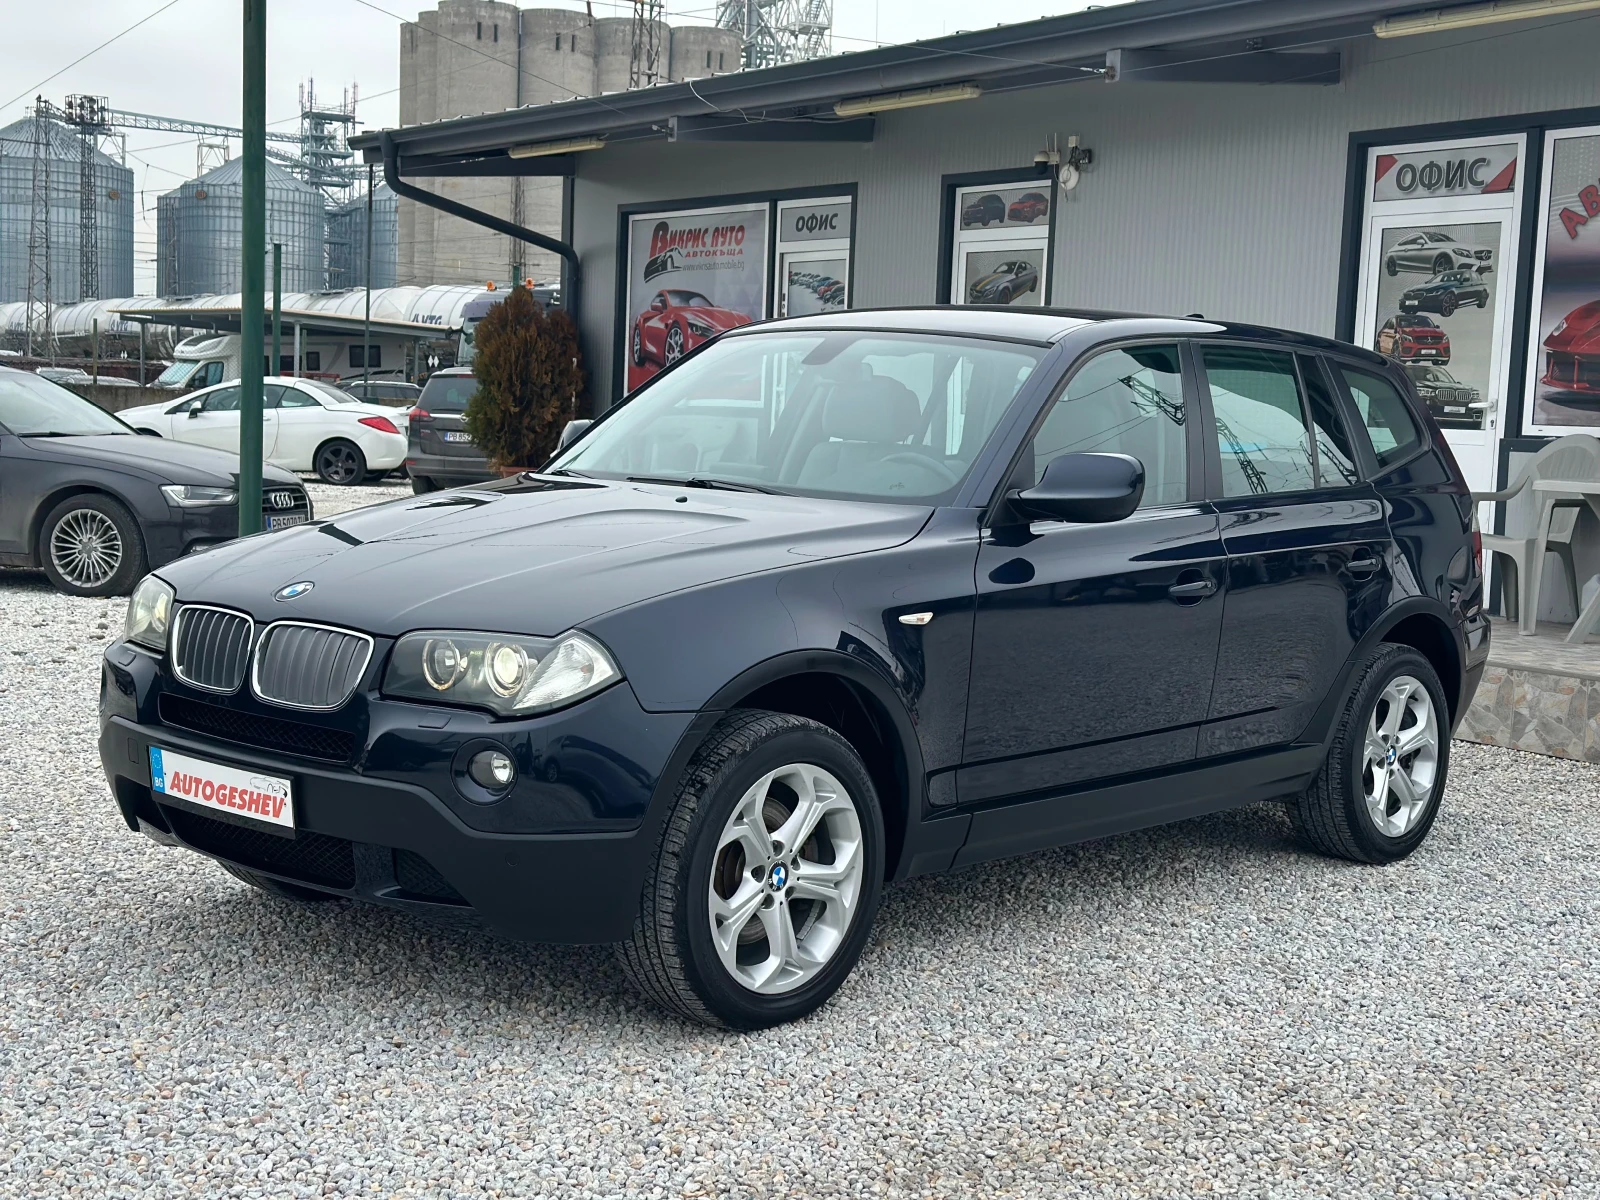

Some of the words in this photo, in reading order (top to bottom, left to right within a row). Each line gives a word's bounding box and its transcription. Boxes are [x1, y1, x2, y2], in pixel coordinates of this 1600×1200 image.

[1396, 157, 1487, 191] ОФИС
[1559, 178, 1600, 239] АВ
[796, 213, 838, 233] ОФИС
[685, 248, 744, 258] АВТОКЪЩА
[154, 777, 163, 788] BG
[170, 771, 285, 818] AUTOGESHEV
